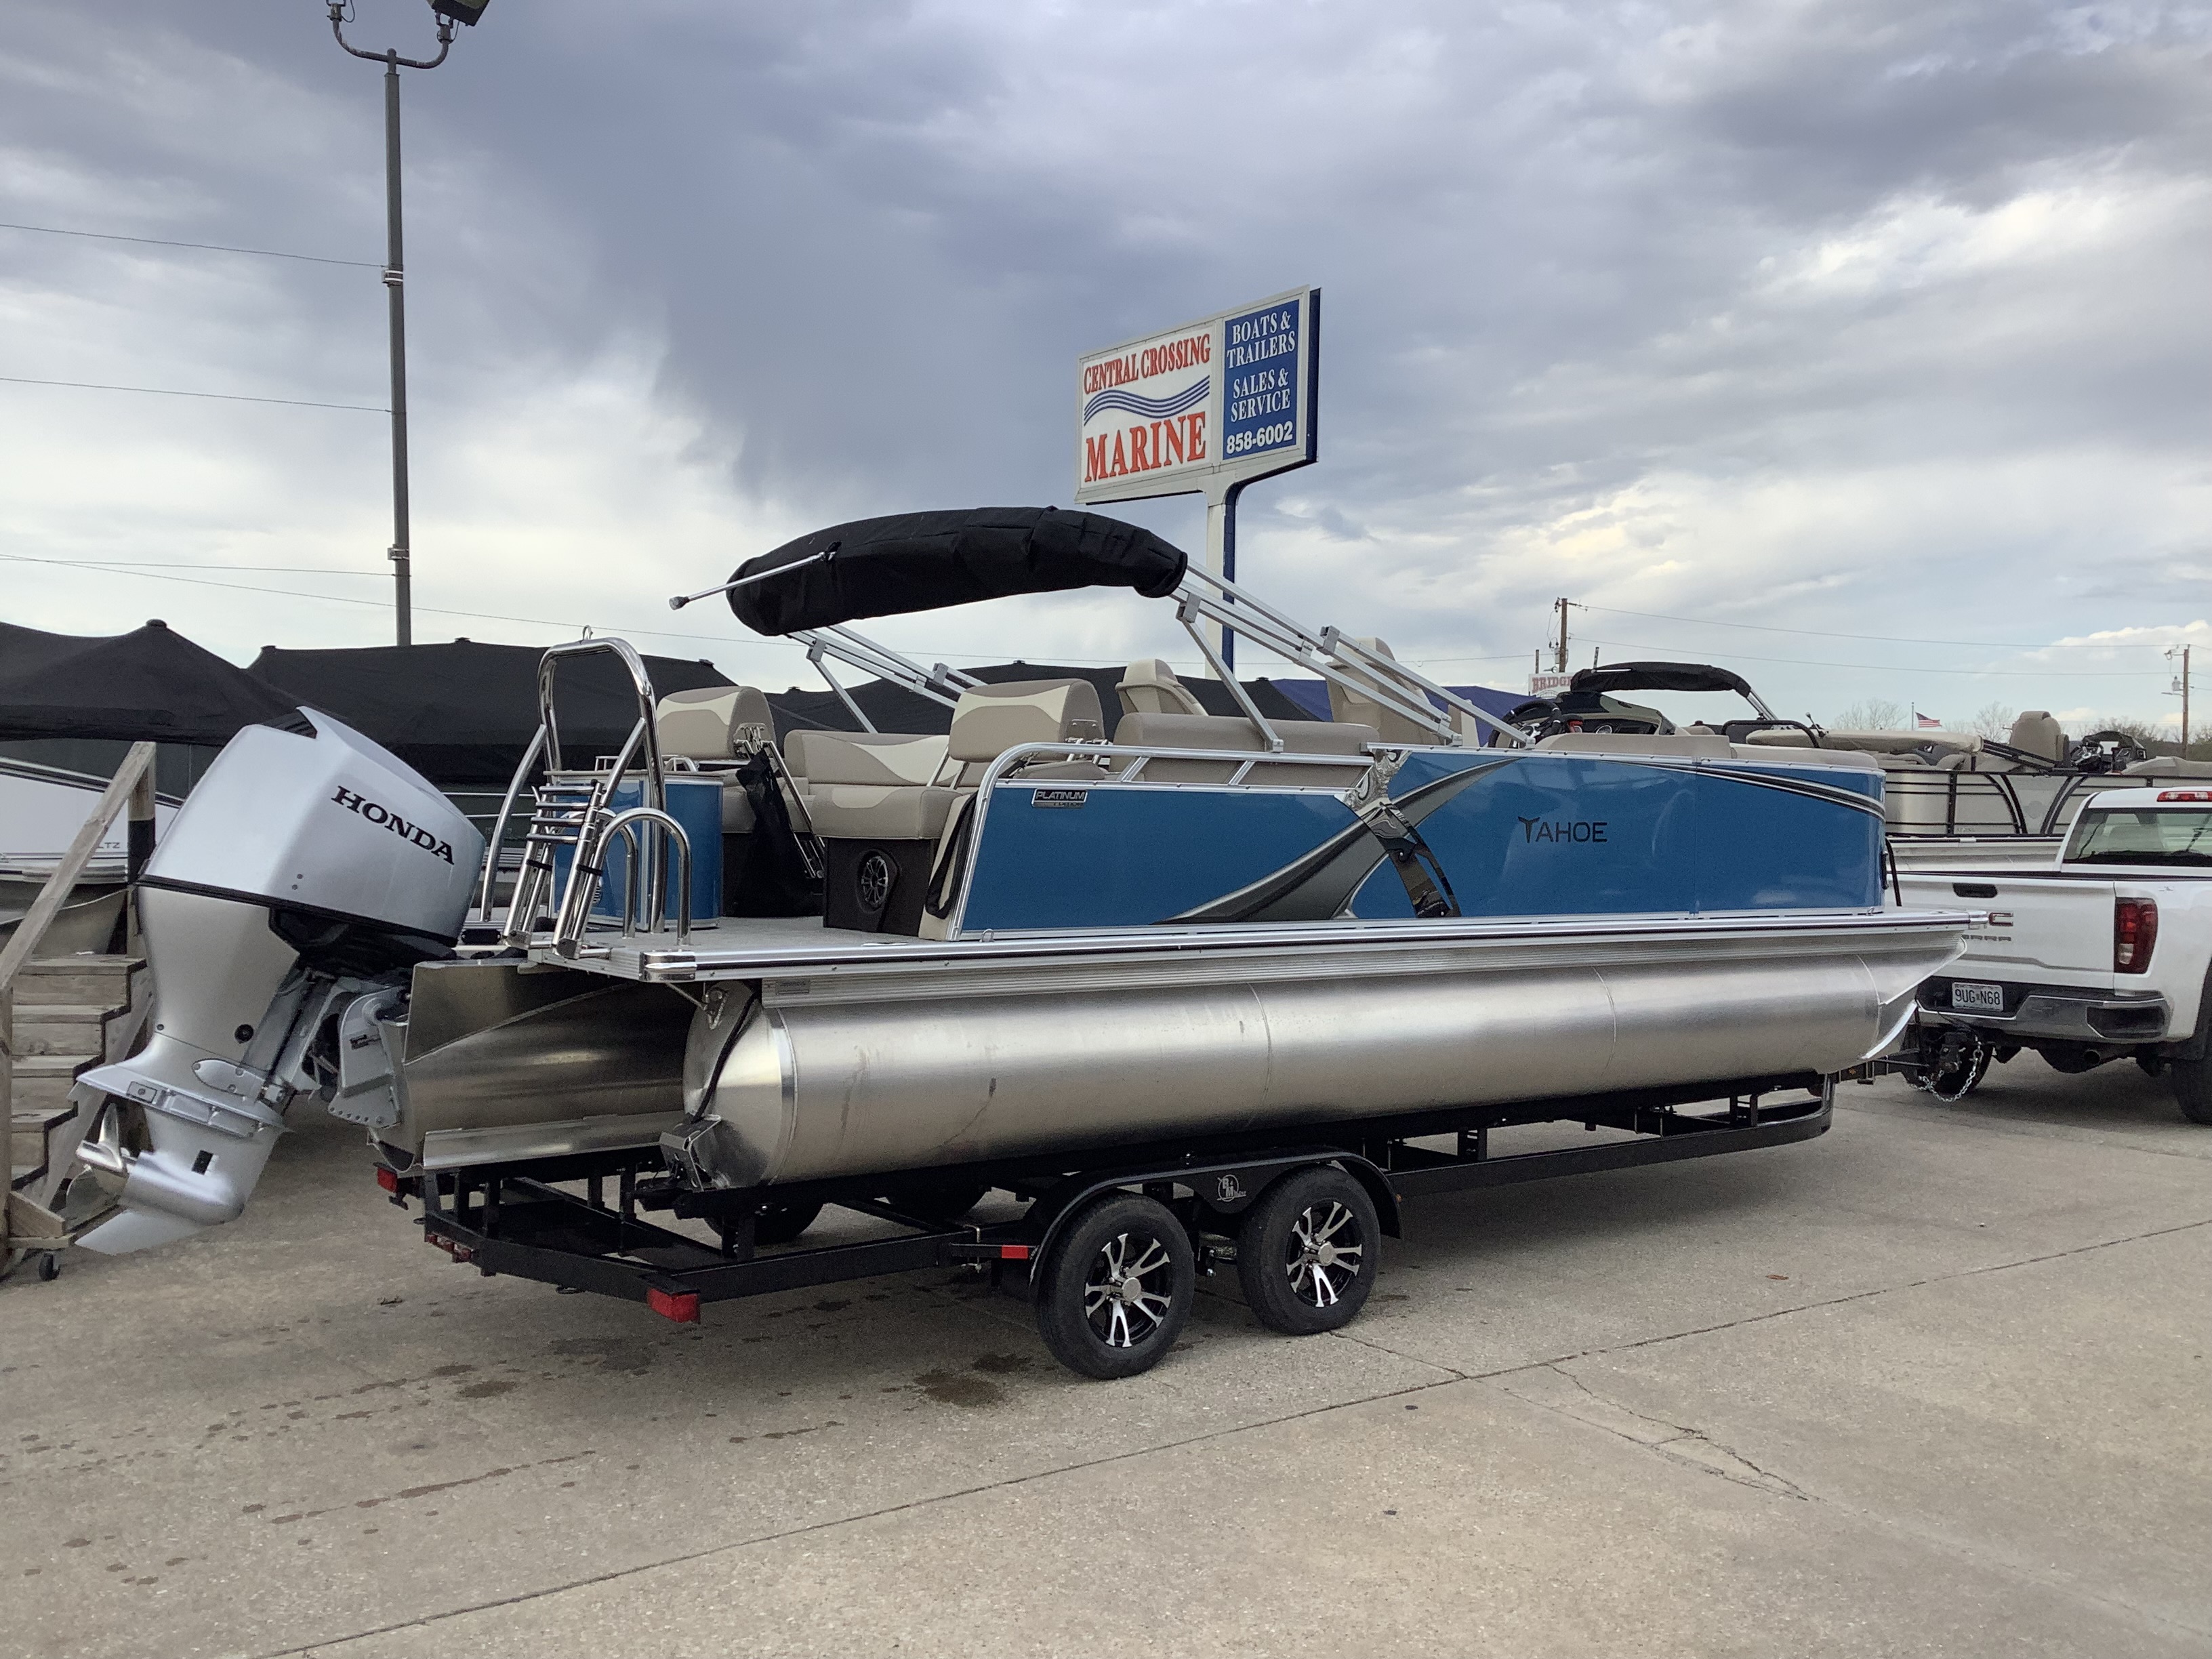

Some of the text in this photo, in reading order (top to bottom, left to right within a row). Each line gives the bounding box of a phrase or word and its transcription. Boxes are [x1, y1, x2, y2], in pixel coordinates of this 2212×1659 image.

[1232, 310, 1291, 345] BOATS &
[1084, 333, 1210, 394] CENTRAL CROSSING
[1227, 330, 1296, 369] TRAILERS
[1233, 367, 1289, 399] SALES &
[1231, 388, 1290, 423] SERVICE
[1084, 411, 1206, 483] MARINE
[1226, 420, 1293, 455] 858-6002
[1036, 791, 1085, 800] PLATINUM
[331, 785, 455, 865] HONDA
[1517, 816, 1607, 843] TAHOE
[1955, 989, 2001, 1005] 9UG N68
